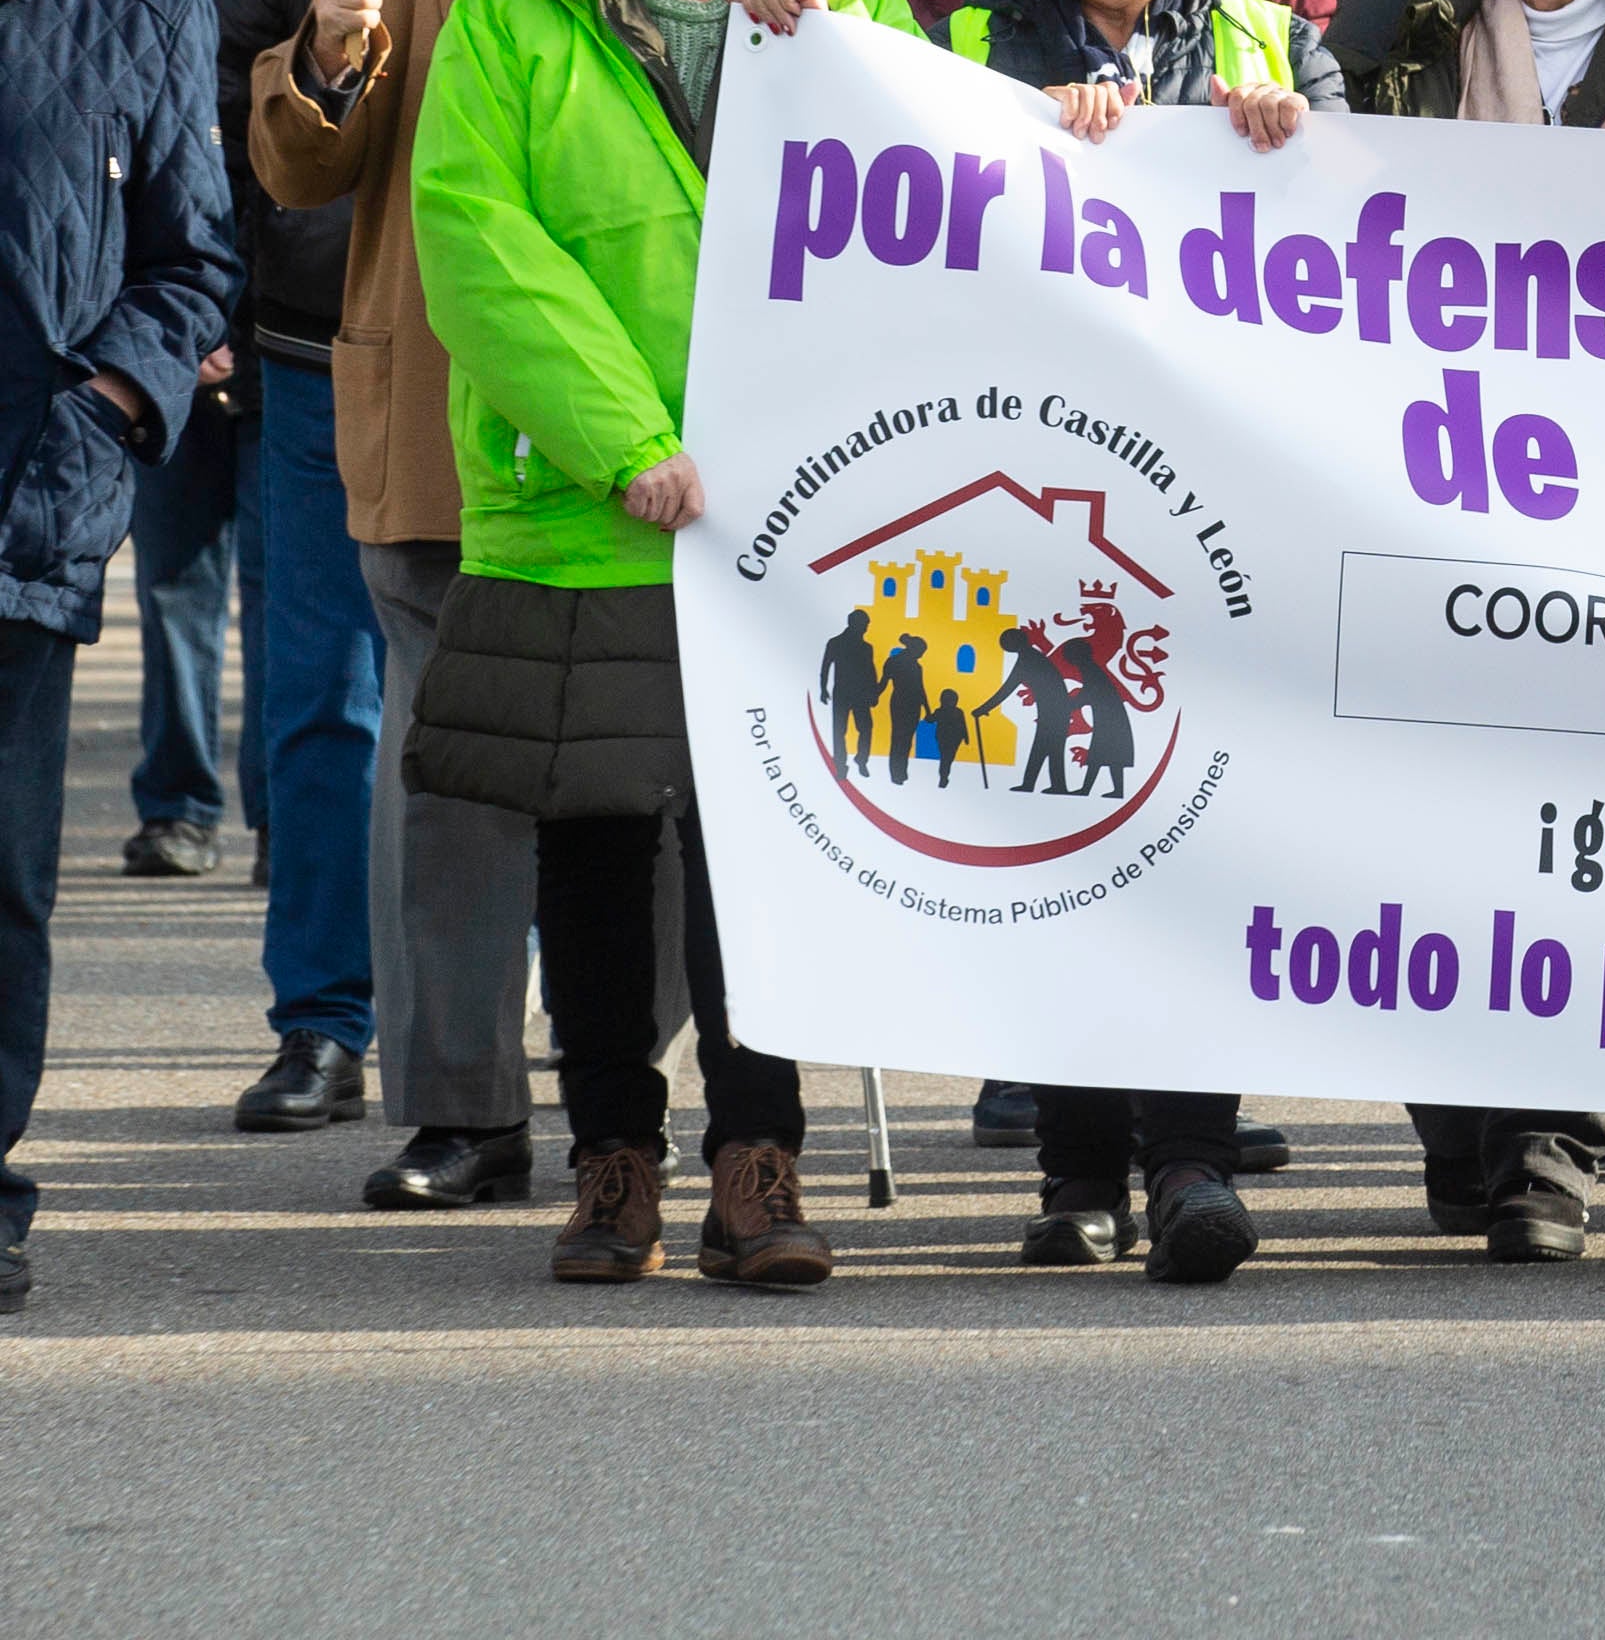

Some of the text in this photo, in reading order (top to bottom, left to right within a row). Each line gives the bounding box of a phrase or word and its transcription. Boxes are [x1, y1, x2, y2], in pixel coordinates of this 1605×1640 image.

[768, 138, 1006, 302] por
[1037, 144, 1149, 300] la
[735, 386, 1254, 620] Coordinadora de Castilla y León
[1401, 367, 1580, 521] de
[745, 706, 1232, 926] Por la Defensa del Sistema Público de Pensiones
[1245, 902, 1460, 1012] todo
[1487, 909, 1574, 1018] lo
